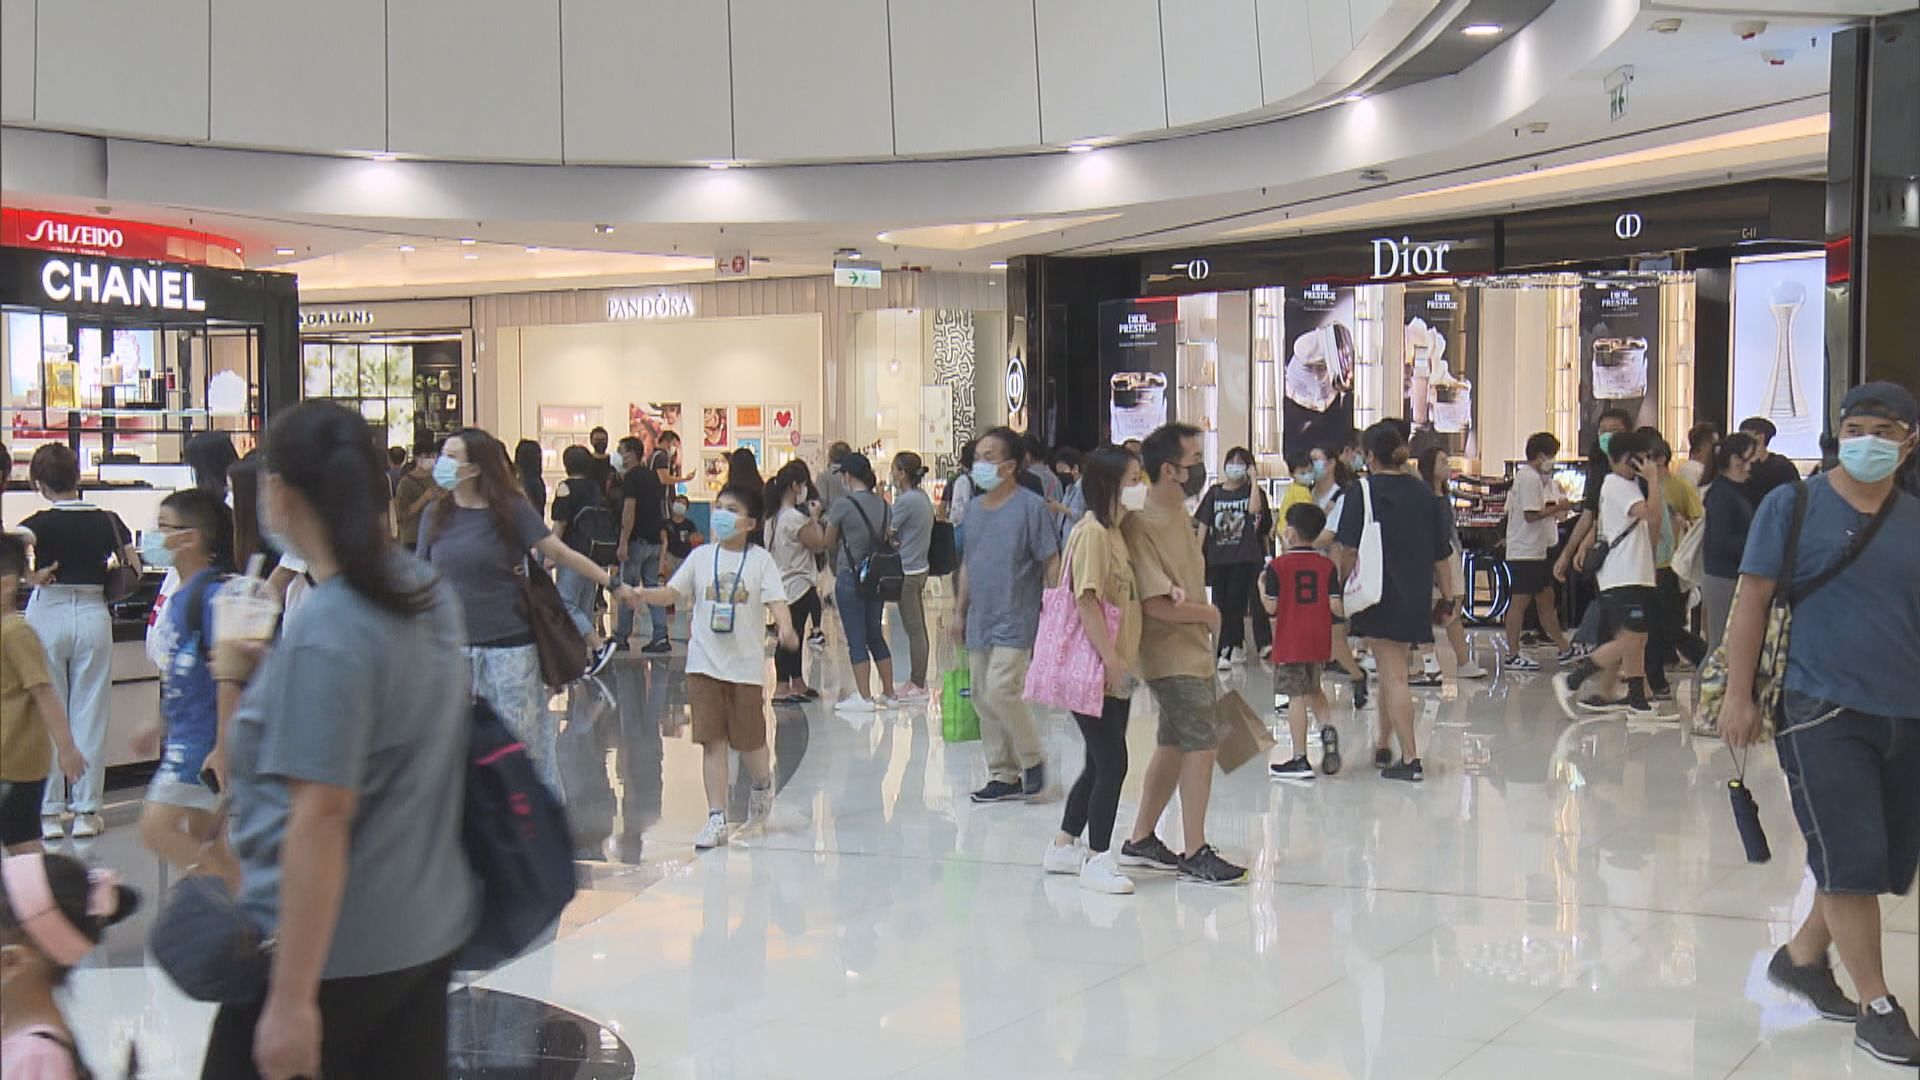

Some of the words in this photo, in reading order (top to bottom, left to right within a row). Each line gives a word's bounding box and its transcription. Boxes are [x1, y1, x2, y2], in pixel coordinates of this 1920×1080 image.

[26, 220, 123, 248] SHISEIDO
[1370, 236, 1449, 279] Dior
[42, 260, 206, 311] CHANEL
[607, 293, 692, 319] PANDORA
[1602, 298, 1638, 307] PRESTIGE
[307, 312, 374, 325] ORIGINS
[1119, 323, 1157, 334] PRESTIGE
[1296, 571, 1317, 604] 8
